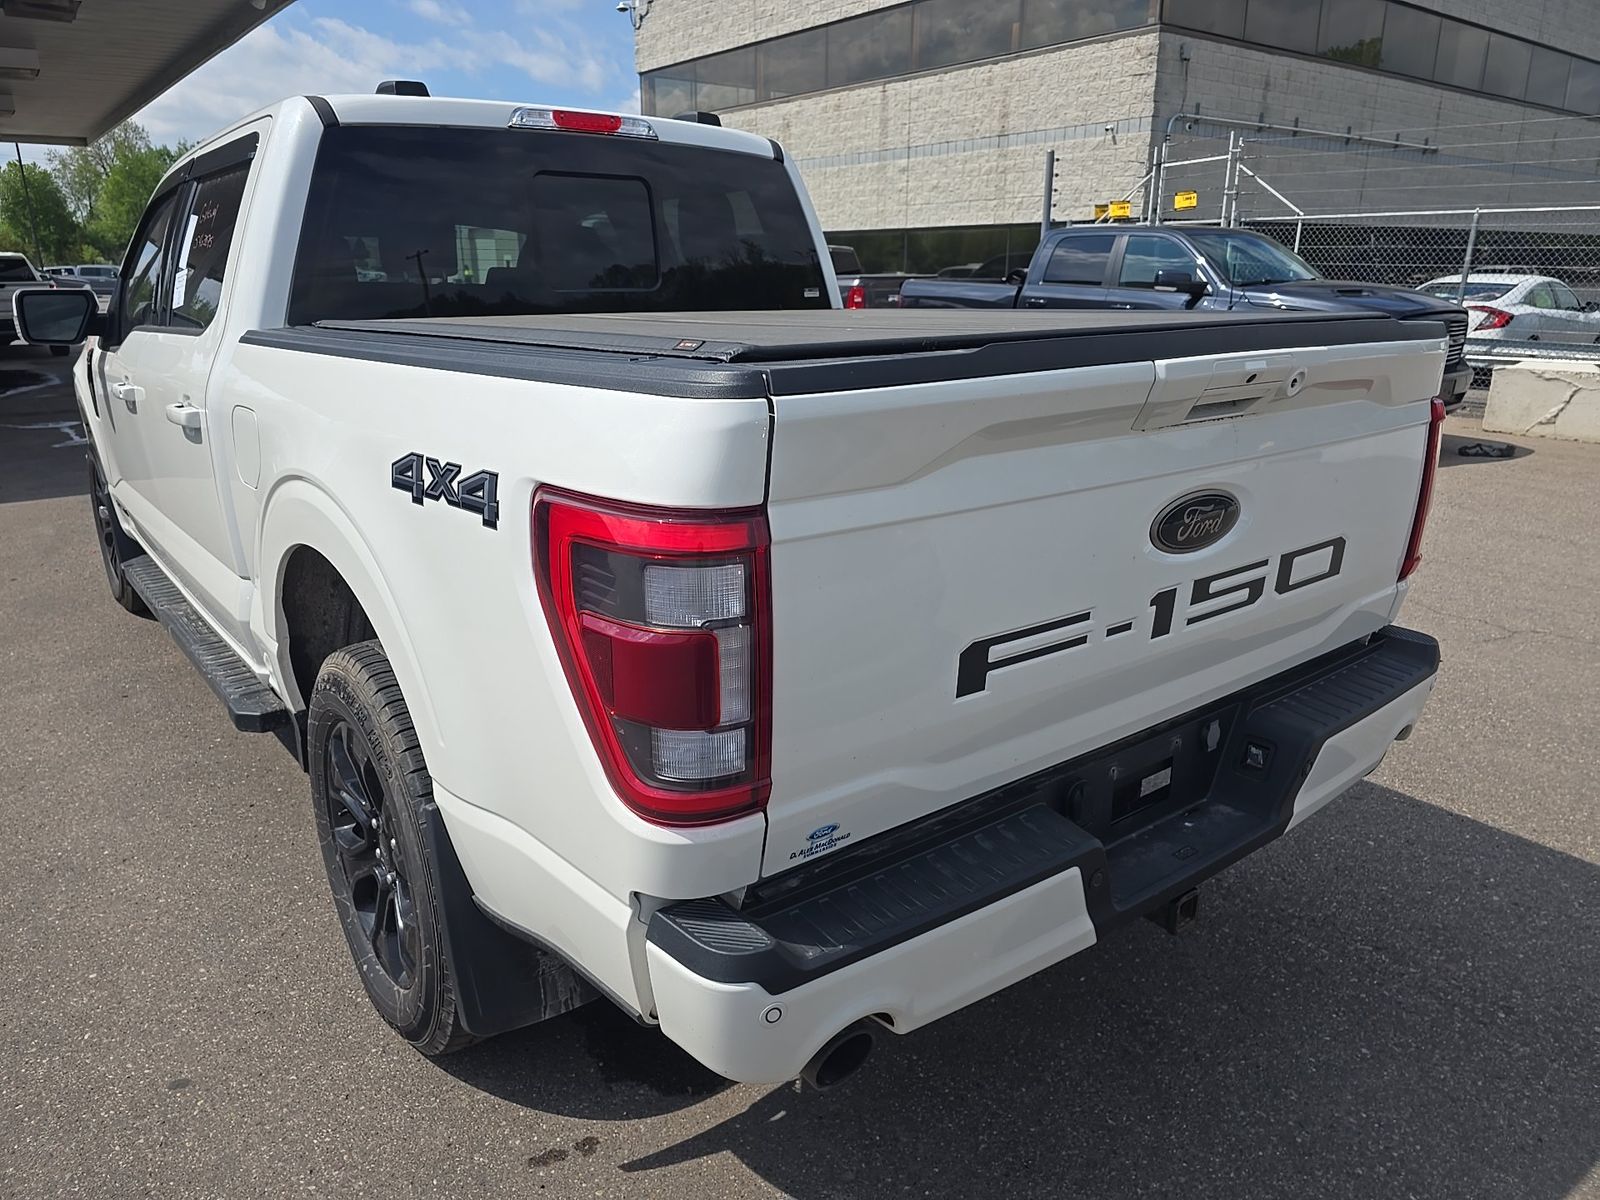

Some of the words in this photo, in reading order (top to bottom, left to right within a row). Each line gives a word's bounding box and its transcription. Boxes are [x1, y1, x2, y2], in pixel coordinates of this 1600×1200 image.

[391, 451, 499, 531] 4X4
[1177, 503, 1226, 542] Ford
[955, 535, 1347, 699] F-150
